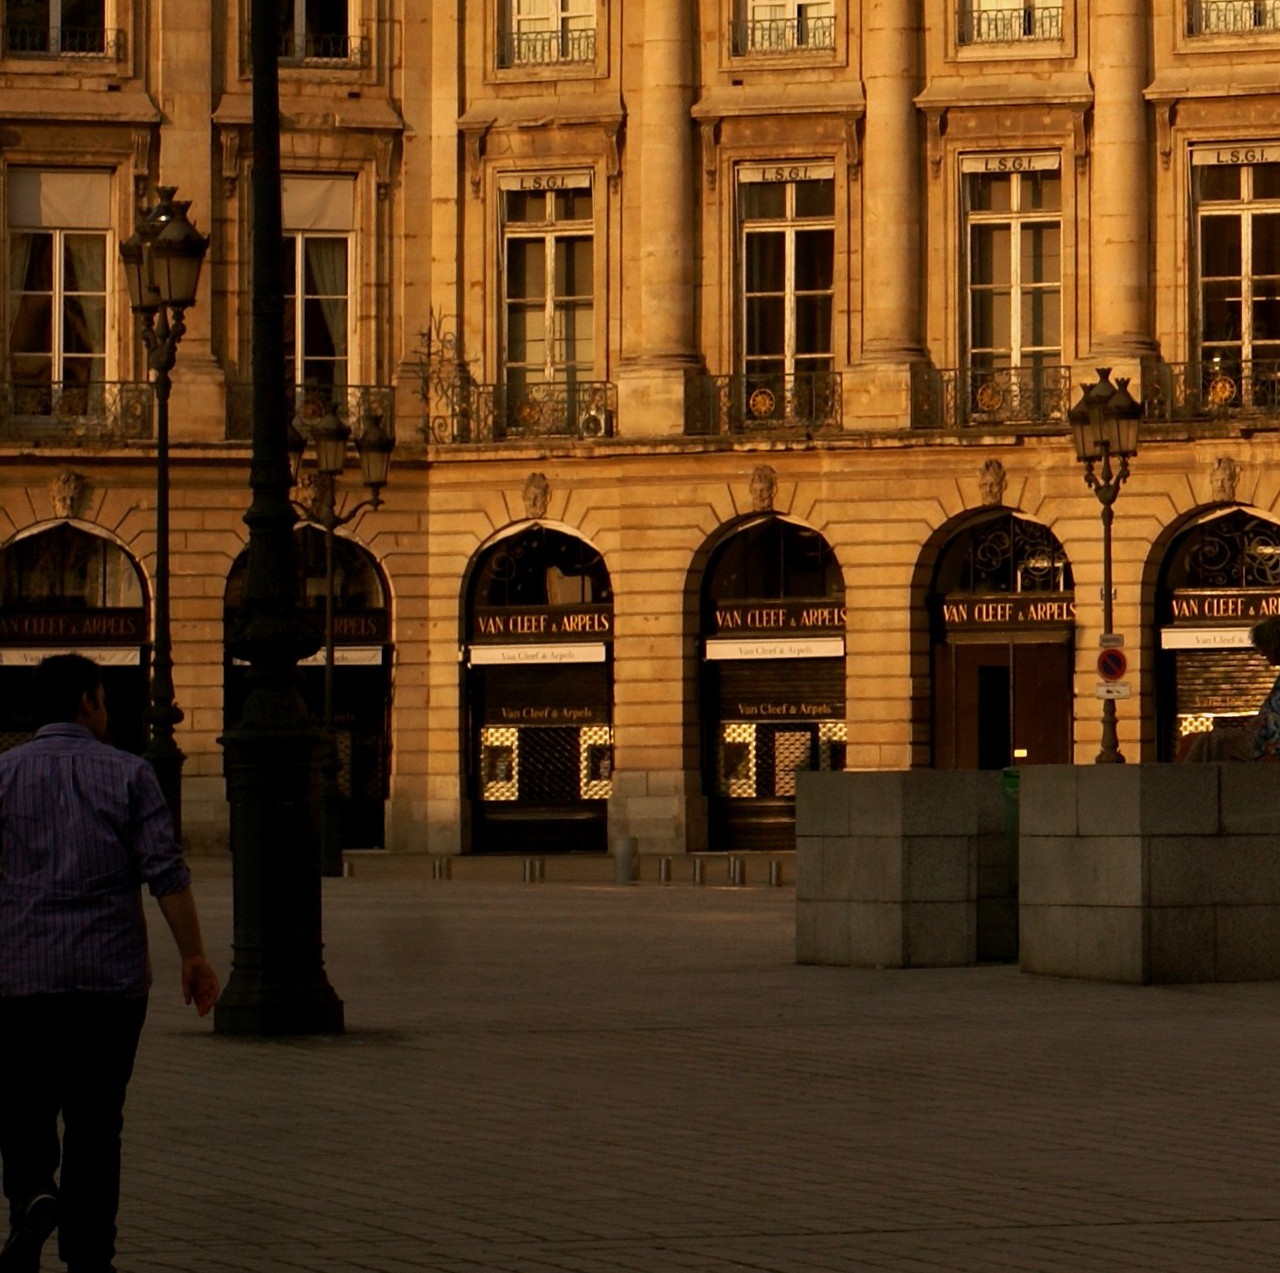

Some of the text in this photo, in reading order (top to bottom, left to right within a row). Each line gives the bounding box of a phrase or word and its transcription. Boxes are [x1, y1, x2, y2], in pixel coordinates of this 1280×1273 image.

[985, 157, 1035, 171] L.S.G.I.
[1217, 149, 1268, 163] L.S.G.I.
[762, 166, 811, 181] L.S.G.I.
[520, 176, 568, 189] L.S.G.I.
[943, 604, 967, 622] VAN
[974, 603, 1014, 621] CLEEF
[1027, 602, 1076, 621] ARPELS
[1173, 599, 1198, 617] VAN
[1203, 598, 1246, 617] CLEEF
[0, 617, 19, 635] AN
[24, 616, 67, 634] CLEEF
[82, 615, 136, 635] ARPELS
[333, 616, 377, 635] RPELS
[478, 615, 504, 634] VAN
[509, 614, 548, 633] CLEEF
[561, 613, 609, 633] ARPELS
[715, 610, 741, 628] VAN
[747, 608, 787, 627] CLEEF
[800, 607, 847, 626] ARPELS
[501, 708, 520, 719] Van
[522, 707, 550, 718] Cleef
[562, 707, 592, 720] Arpels
[738, 704, 757, 714] Van
[760, 703, 787, 714] Cleef
[800, 702, 832, 716] Arpels
